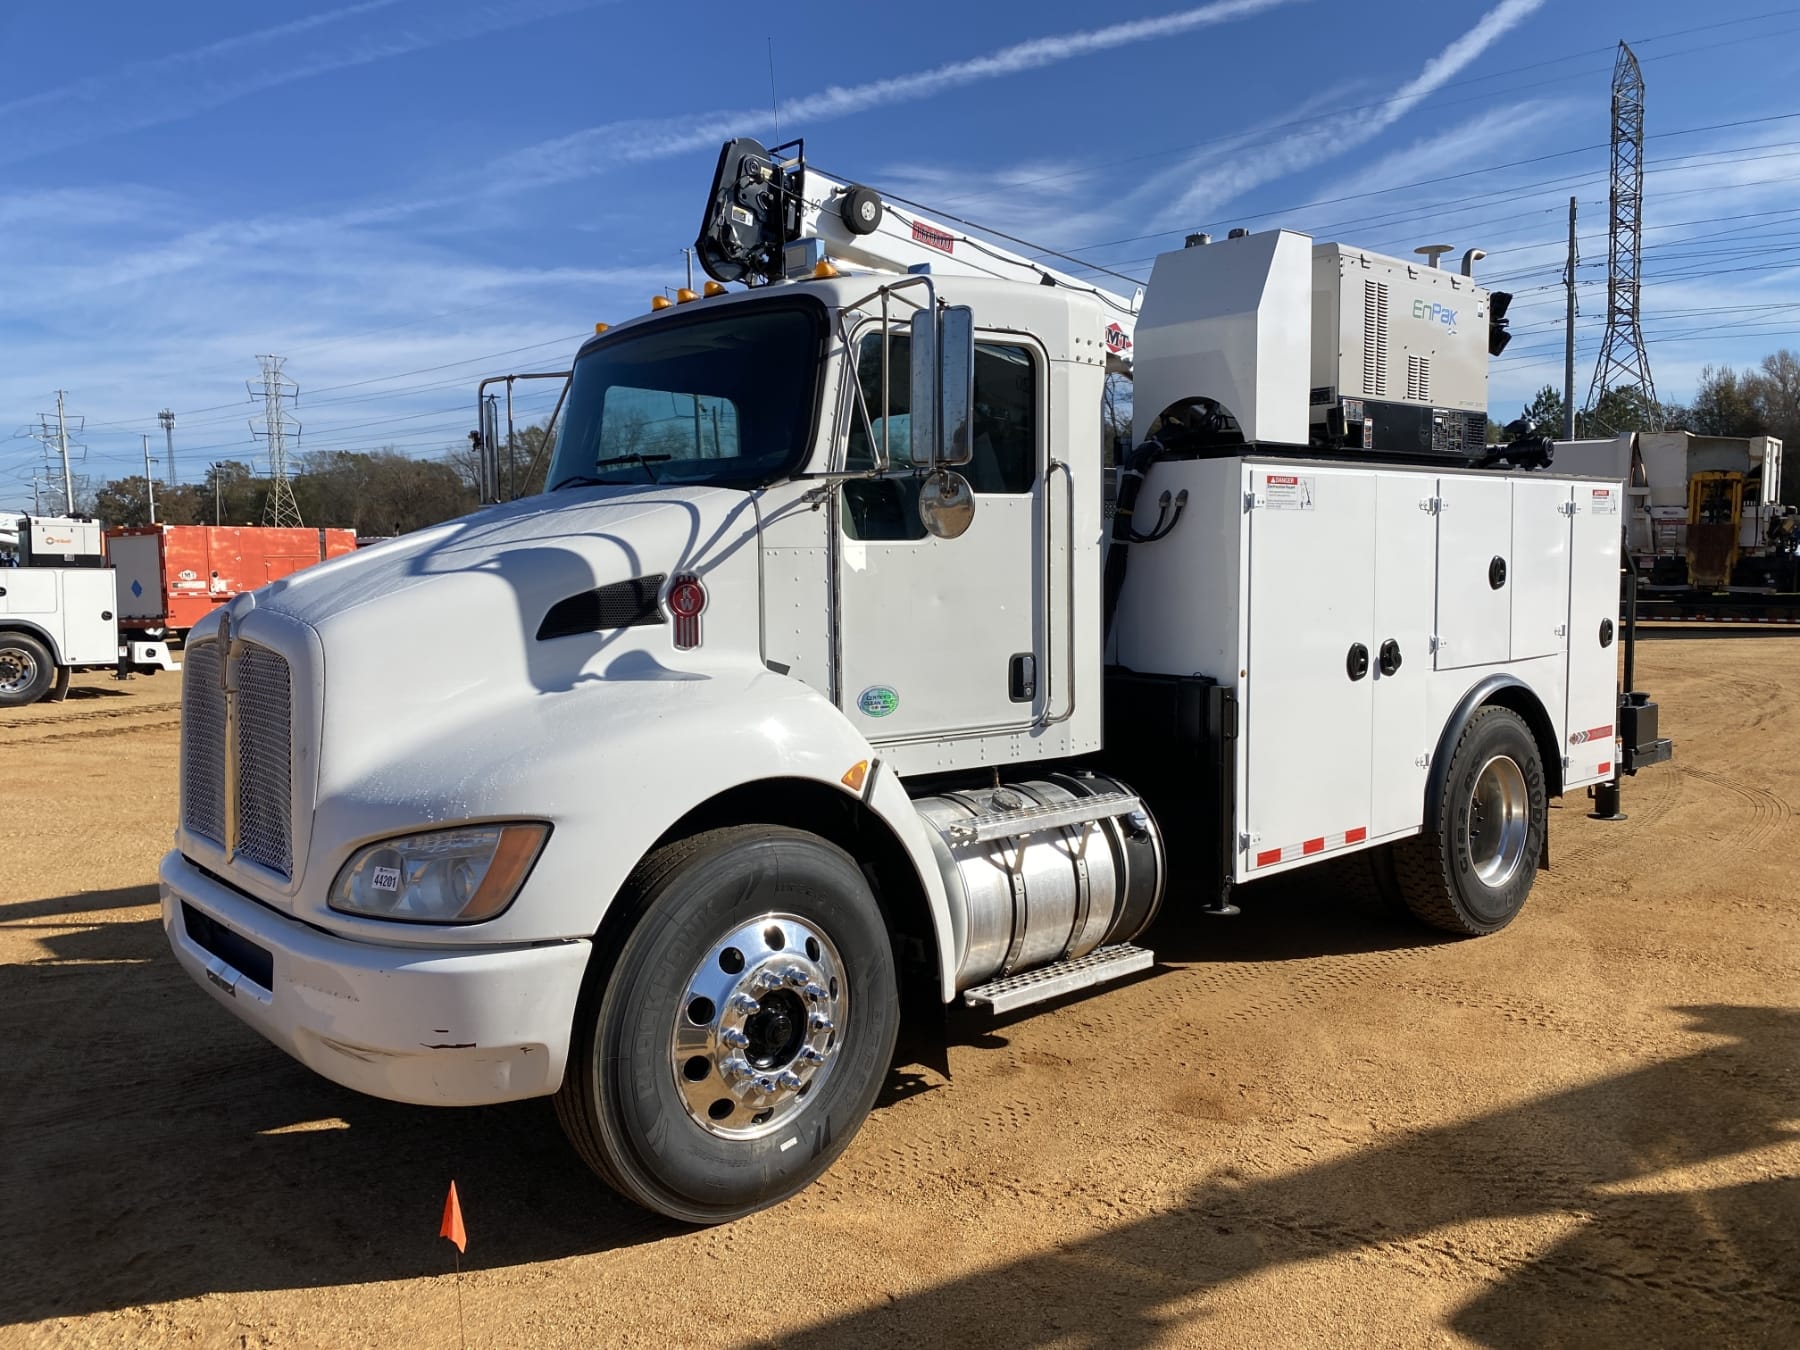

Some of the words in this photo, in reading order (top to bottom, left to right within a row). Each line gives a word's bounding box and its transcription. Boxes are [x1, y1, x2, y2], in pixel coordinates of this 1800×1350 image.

[1413, 299, 1458, 326] EnPak
[1106, 327, 1130, 350] MT
[374, 874, 396, 889] 44201
